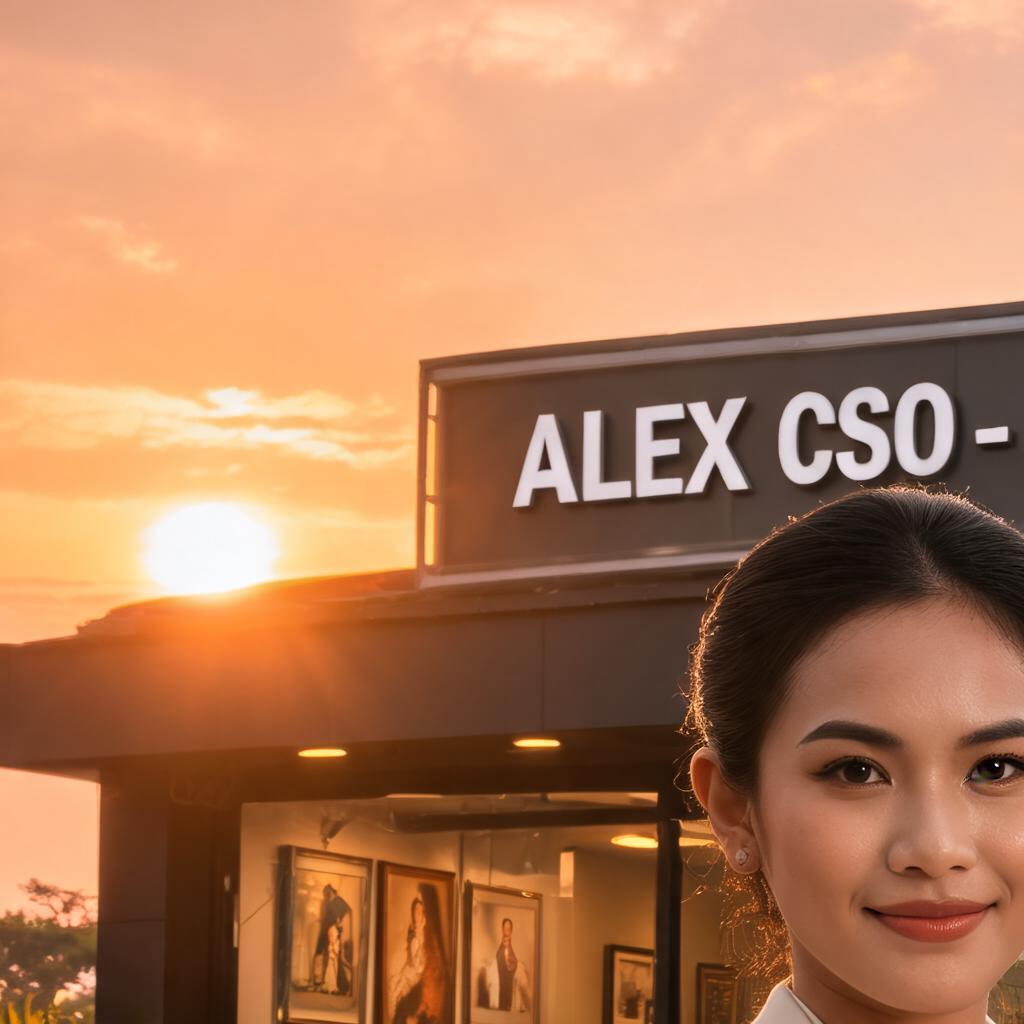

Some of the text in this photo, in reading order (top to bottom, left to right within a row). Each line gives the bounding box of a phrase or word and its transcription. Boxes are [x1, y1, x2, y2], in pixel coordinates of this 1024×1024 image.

[512, 397, 749, 507] ALEX
[778, 382, 955, 484] CSO
[975, 426, 1009, 446] -
